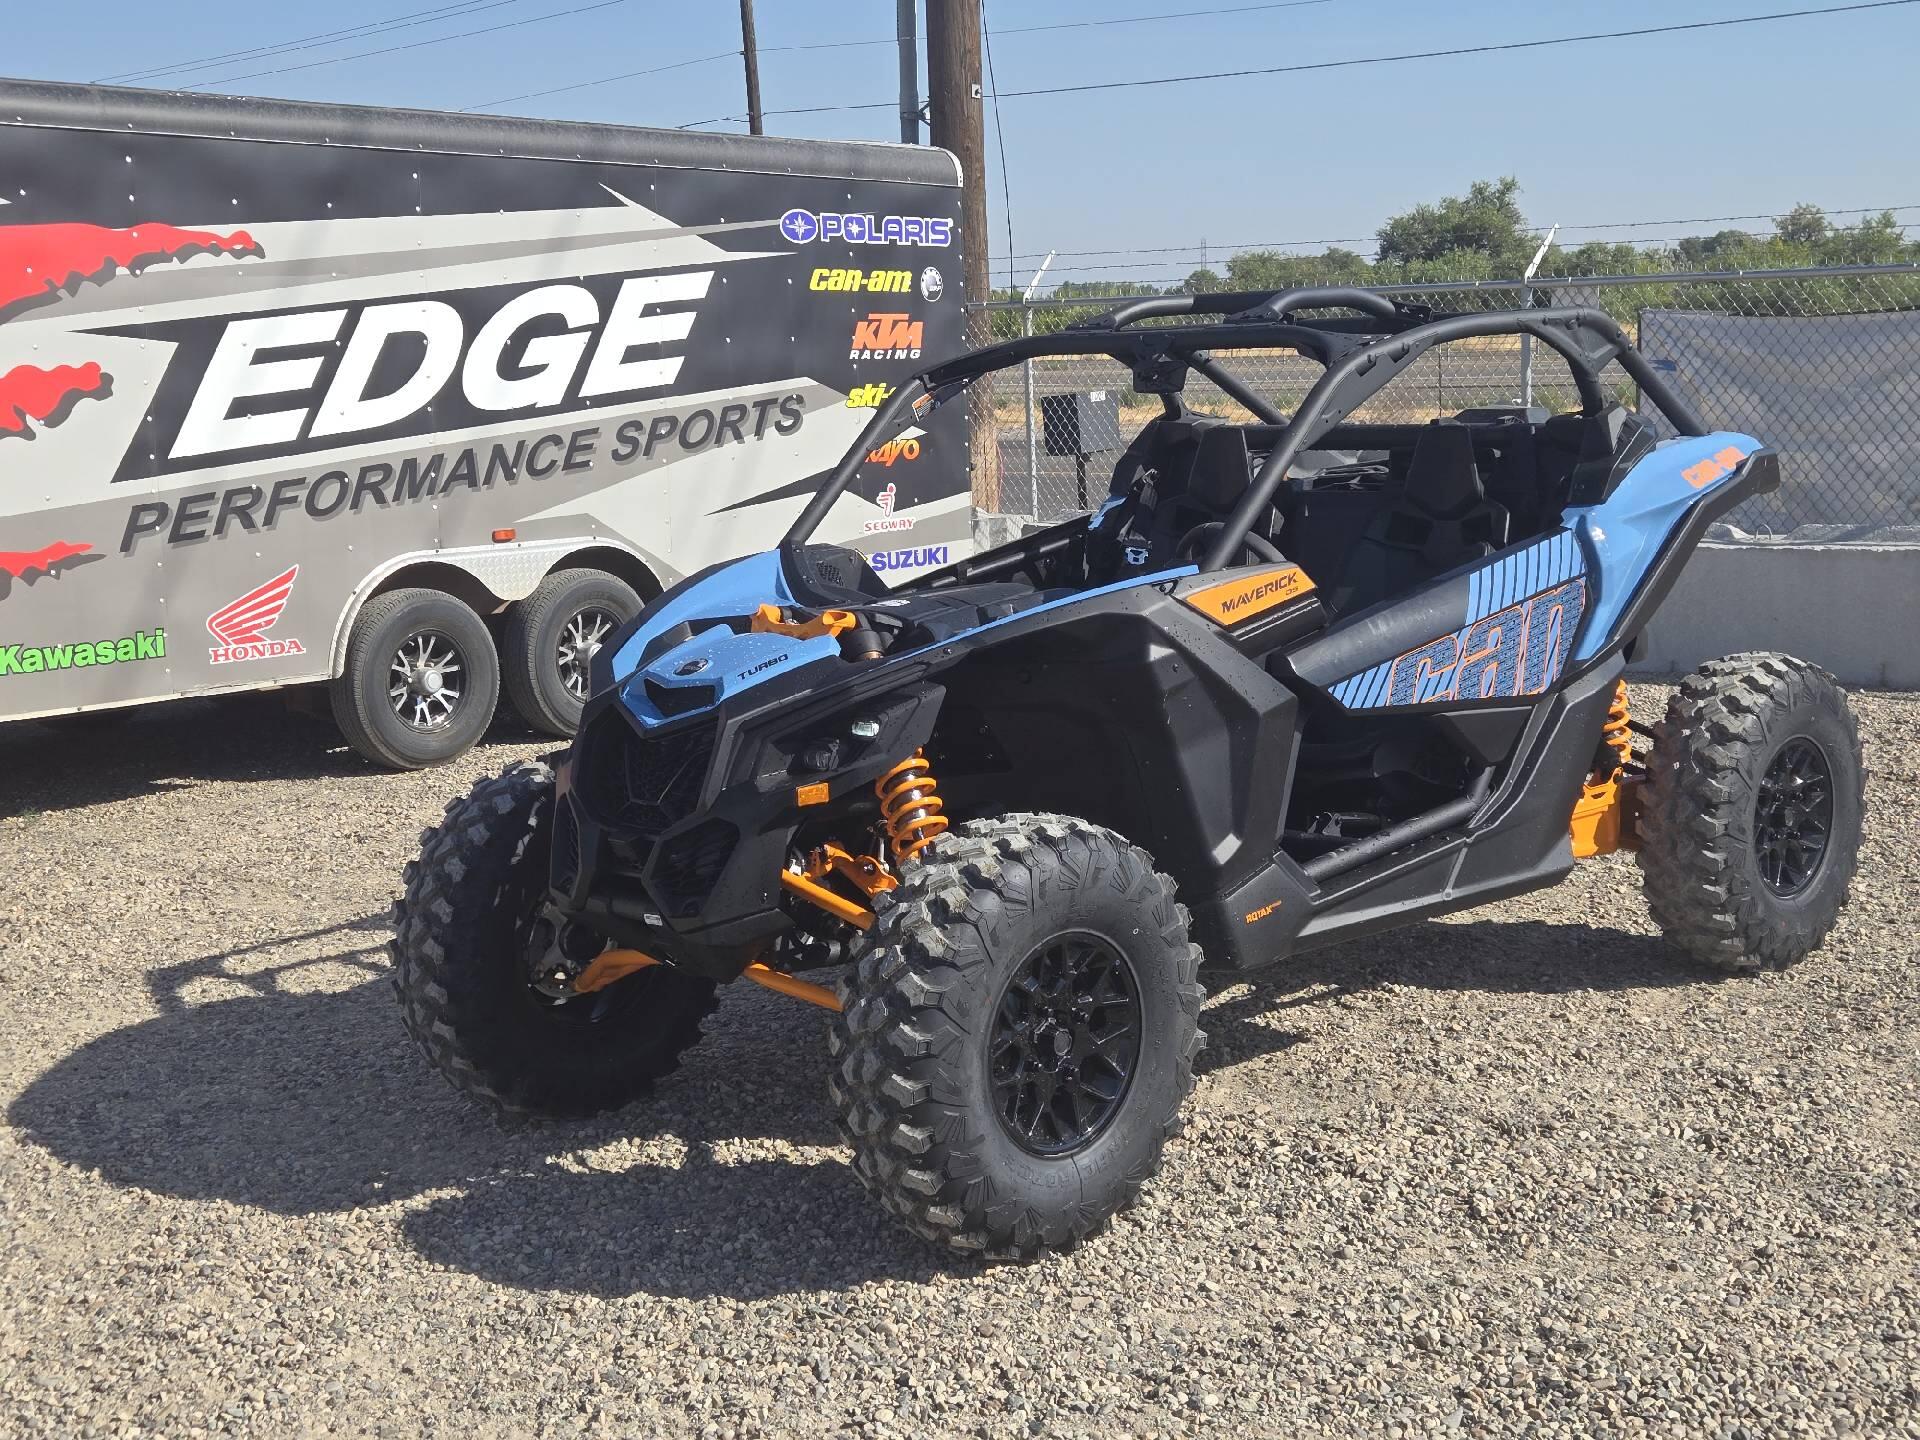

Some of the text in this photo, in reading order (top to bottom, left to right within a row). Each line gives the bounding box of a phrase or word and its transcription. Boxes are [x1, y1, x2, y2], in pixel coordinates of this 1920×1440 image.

[820, 213, 952, 247] POLARIS
[852, 313, 924, 349] KTM
[168, 271, 715, 460] EDGE
[849, 349, 921, 360] RACING
[119, 394, 807, 557] PERFORMANCE SPORTS
[864, 518, 914, 532] SEGWAY
[872, 547, 948, 571] SUZUKI
[1221, 572, 1298, 614] MAVERICK
[0, 627, 167, 676] Kawasaki
[209, 638, 306, 664] HONDA
[737, 653, 789, 680] TURBO
[1246, 904, 1273, 924] ROTAX
